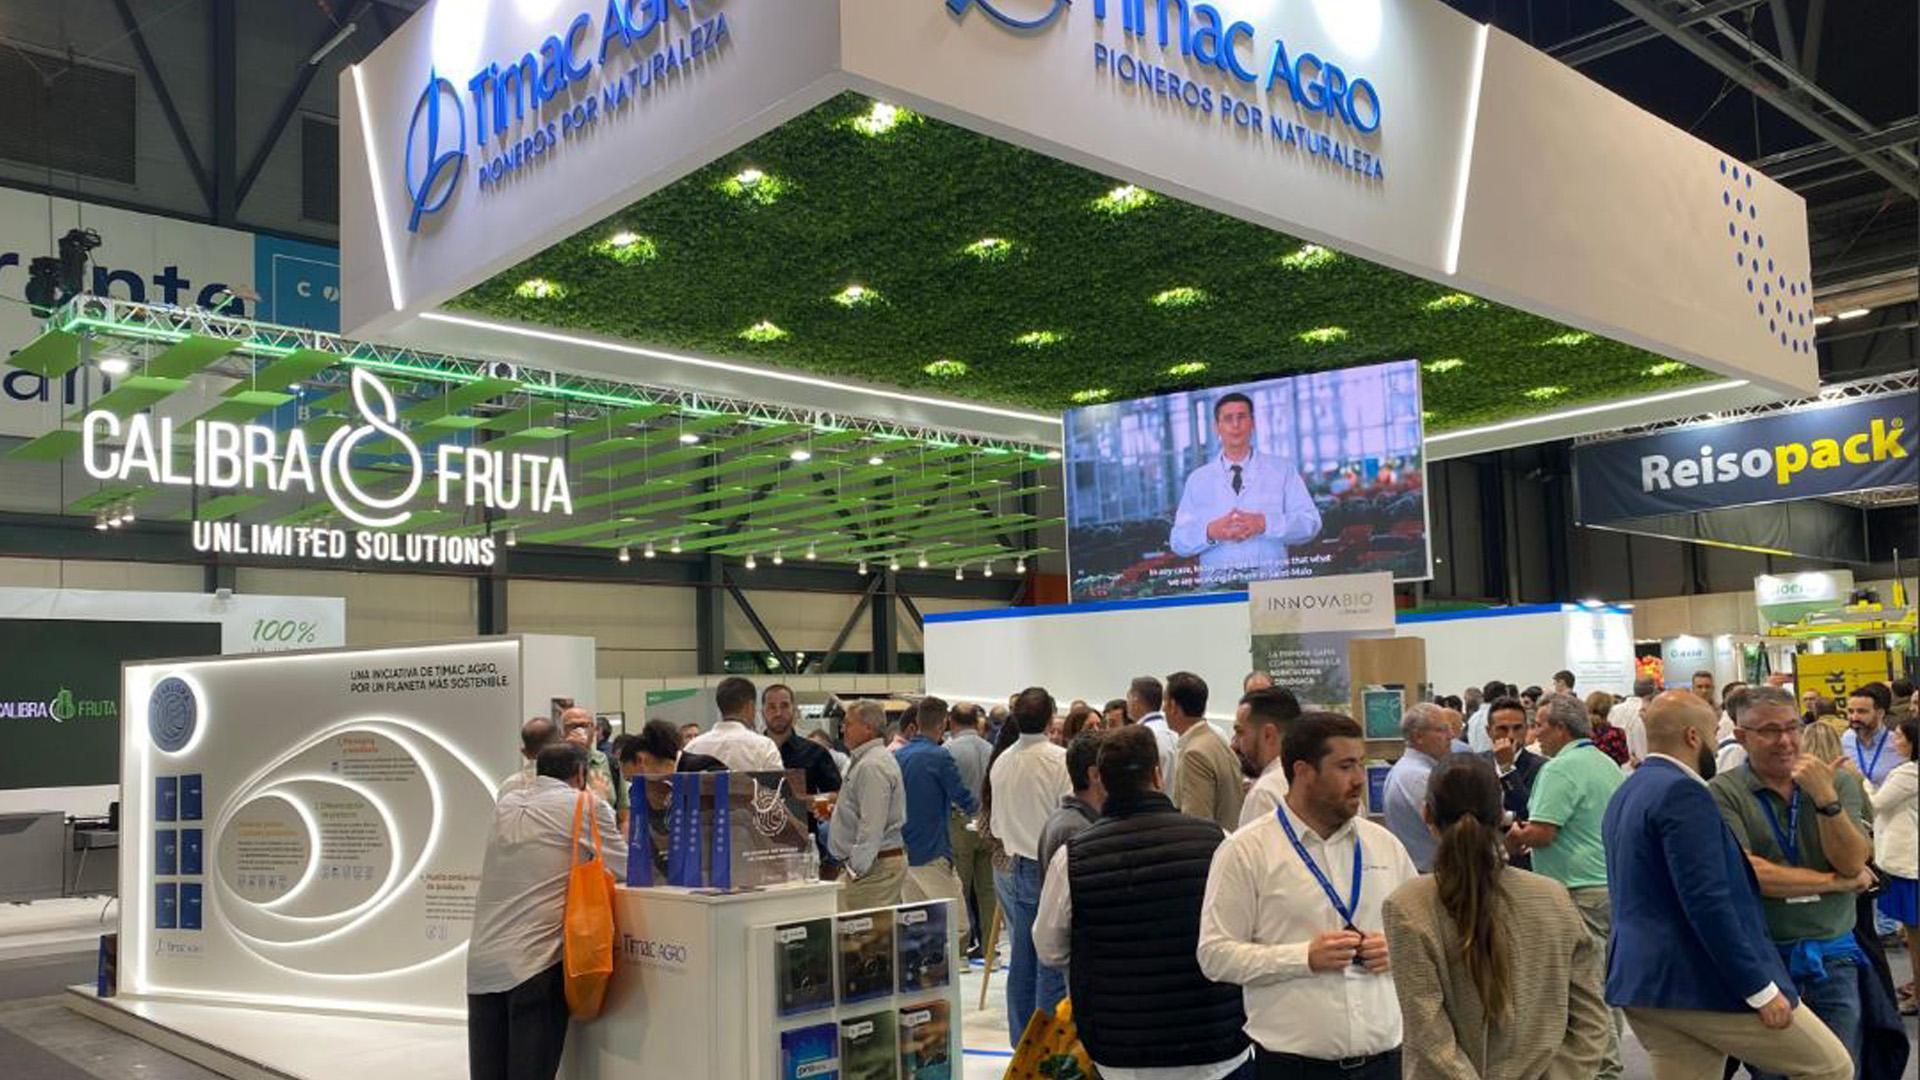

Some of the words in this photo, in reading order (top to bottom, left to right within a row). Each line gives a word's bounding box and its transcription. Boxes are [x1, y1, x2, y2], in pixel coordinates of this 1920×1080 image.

[468, 11, 592, 147] Timac
[478, 122, 557, 187] PIONEROS
[562, 95, 597, 138] POR
[603, 12, 729, 112] NATURALEZA
[1266, 40, 1381, 134] AGRO
[1094, 42, 1212, 112] PIONEROS
[1221, 95, 1263, 132] POR
[1271, 117, 1384, 180] NATURALEZA
[82, 409, 315, 493] CALIBRA
[438, 445, 573, 515] FRUTA
[192, 521, 347, 559] UNLIMITED
[356, 530, 495, 567] SOLUTIONS
[1267, 592, 1373, 611] INNOVABIO
[252, 619, 317, 643] 100%
[351, 669, 370, 681] UNA
[373, 667, 418, 680] INICIATIVA
[420, 666, 433, 677] DE
[435, 664, 465, 676] TIMAC
[351, 682, 370, 693] POR
[372, 681, 384, 693] UN
[386, 679, 426, 692] PLANETA
[79, 700, 117, 717] FRUTA
